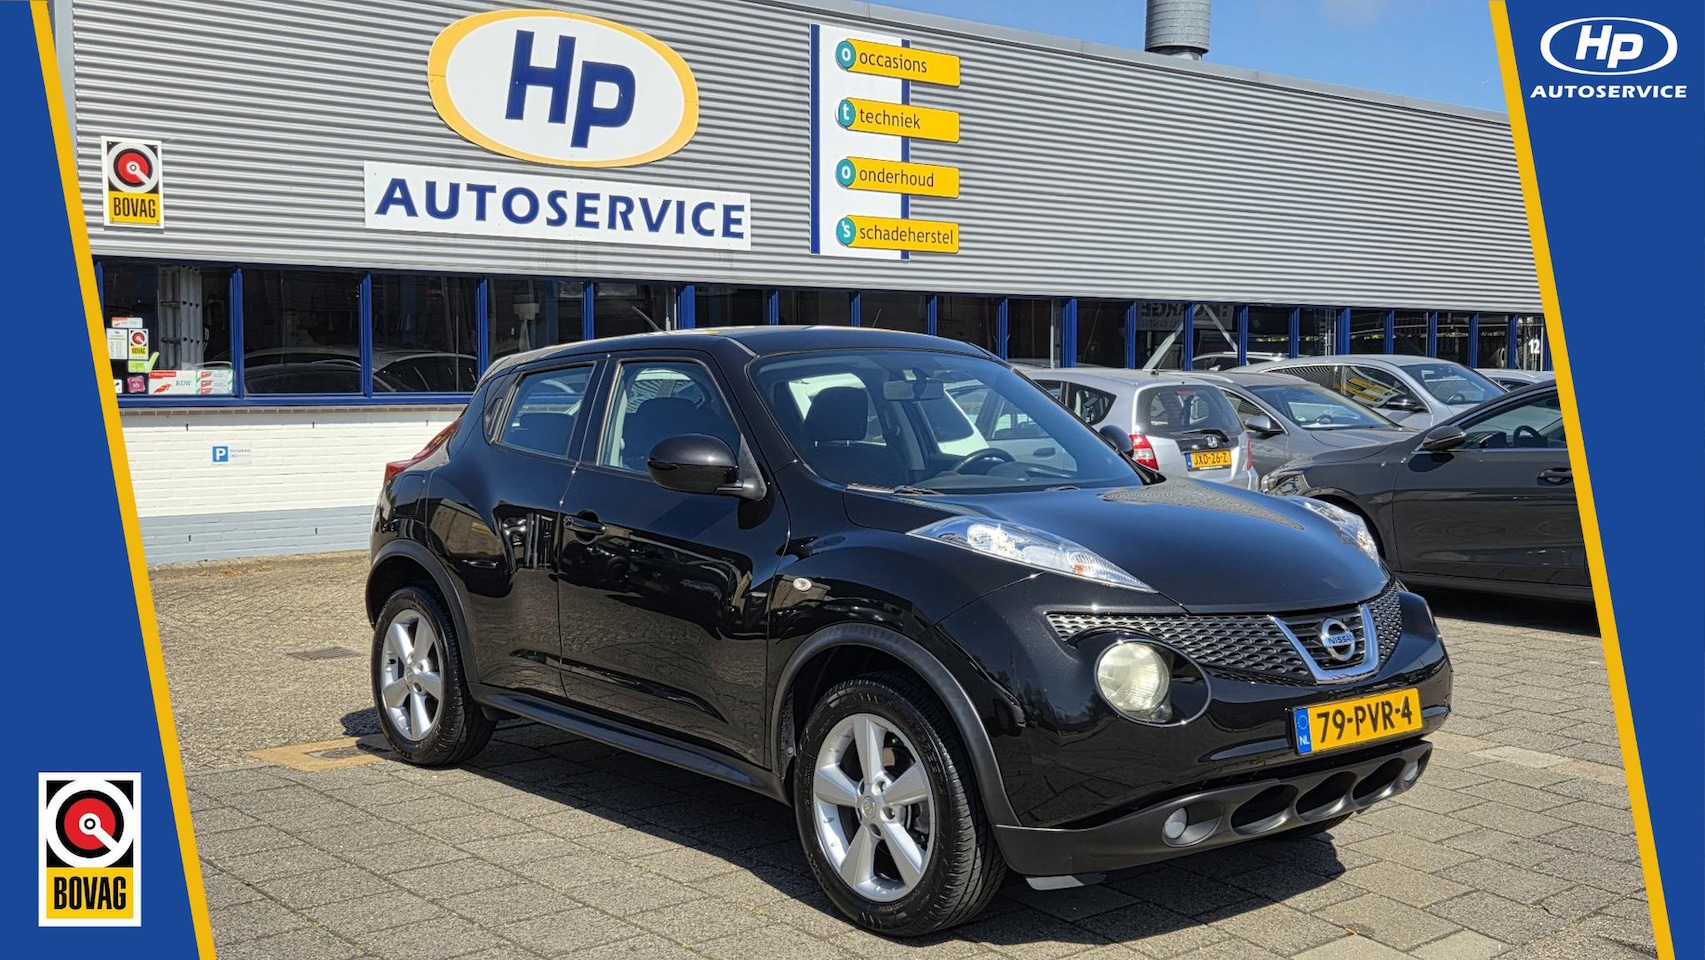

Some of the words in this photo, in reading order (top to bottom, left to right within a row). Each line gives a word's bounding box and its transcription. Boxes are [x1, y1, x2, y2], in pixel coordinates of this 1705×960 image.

[859, 53, 928, 73] occasions
[859, 108, 921, 130] techniek
[859, 168, 935, 188] onderhoud
[113, 197, 156, 218] BOVAG
[374, 177, 745, 240] AUTOSERVICE
[859, 224, 954, 245] schadeherstel
[1528, 339, 1541, 354] 12
[215, 448, 226, 461] P
[1194, 452, 1228, 465] JXD-26-Z
[1316, 695, 1413, 743] 79-PVR-4
[1299, 735, 1310, 746] NL
